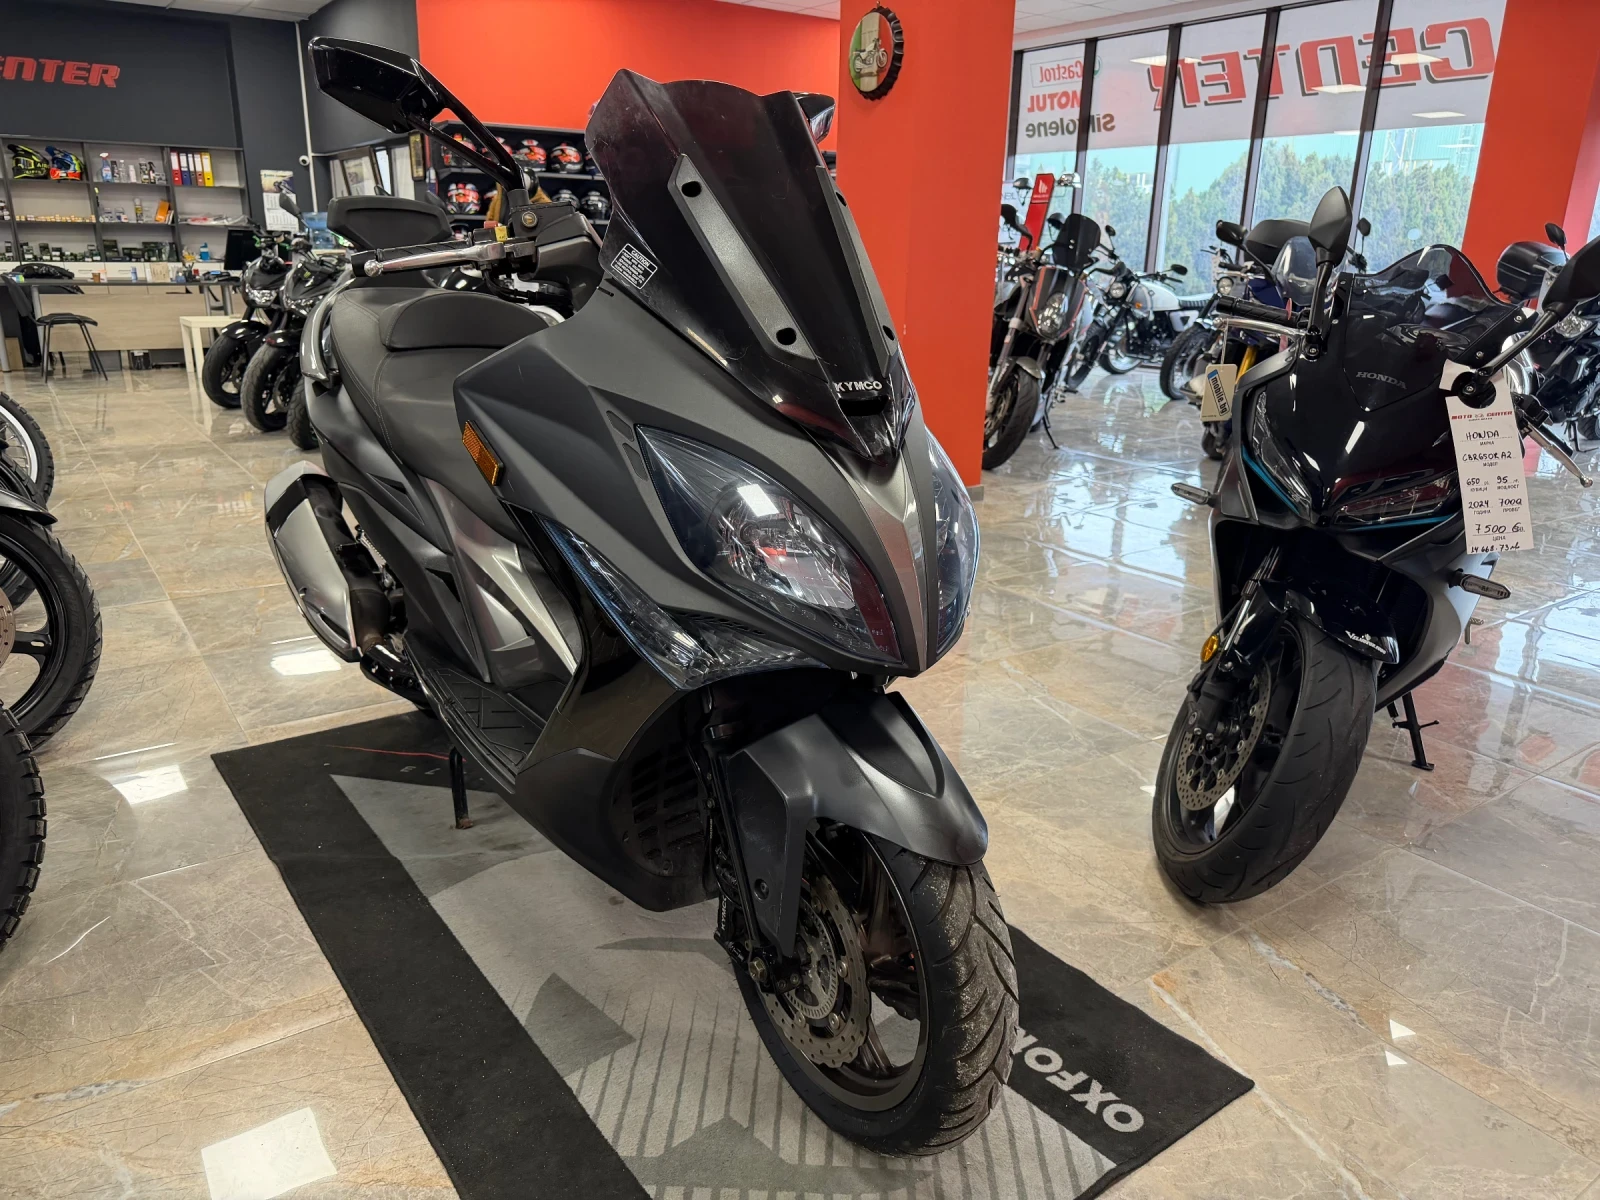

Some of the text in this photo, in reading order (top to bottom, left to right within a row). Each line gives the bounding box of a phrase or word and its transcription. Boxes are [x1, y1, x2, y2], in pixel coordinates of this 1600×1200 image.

[0, 55, 121, 88] NTER
[631, 250, 651, 267] CAUTION
[831, 380, 883, 392] KYMCO
[1355, 371, 1408, 390] HONDA
[1210, 376, 1230, 414] mobile.bg
[1465, 430, 1500, 441] HONDA
[1500, 450, 1512, 460] A2
[1466, 477, 1481, 486] 650
[1496, 475, 1508, 484] 95
[1468, 500, 1489, 509] 2024
